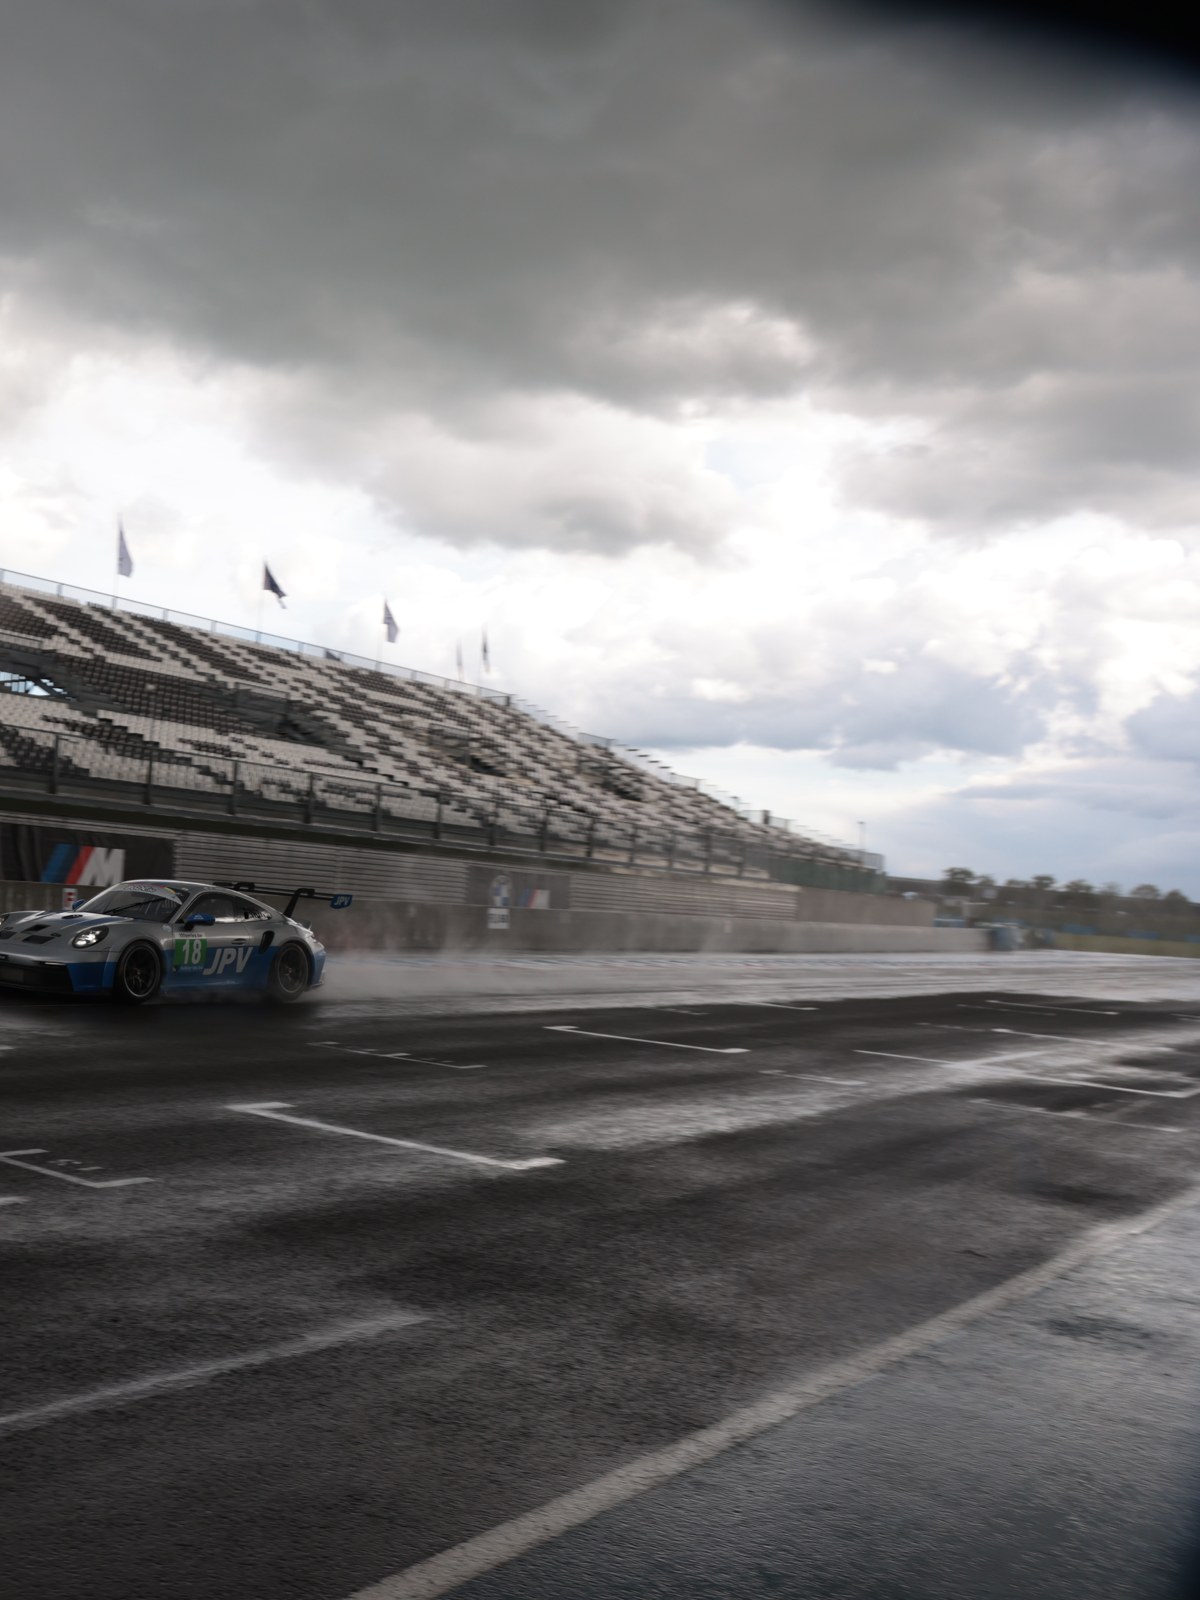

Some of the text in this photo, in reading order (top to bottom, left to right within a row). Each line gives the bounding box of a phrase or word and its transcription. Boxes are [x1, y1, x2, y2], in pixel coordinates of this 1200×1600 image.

[78, 847, 125, 886] M
[334, 895, 350, 907] JPV
[182, 939, 202, 965] 18
[202, 946, 254, 976] JPV
